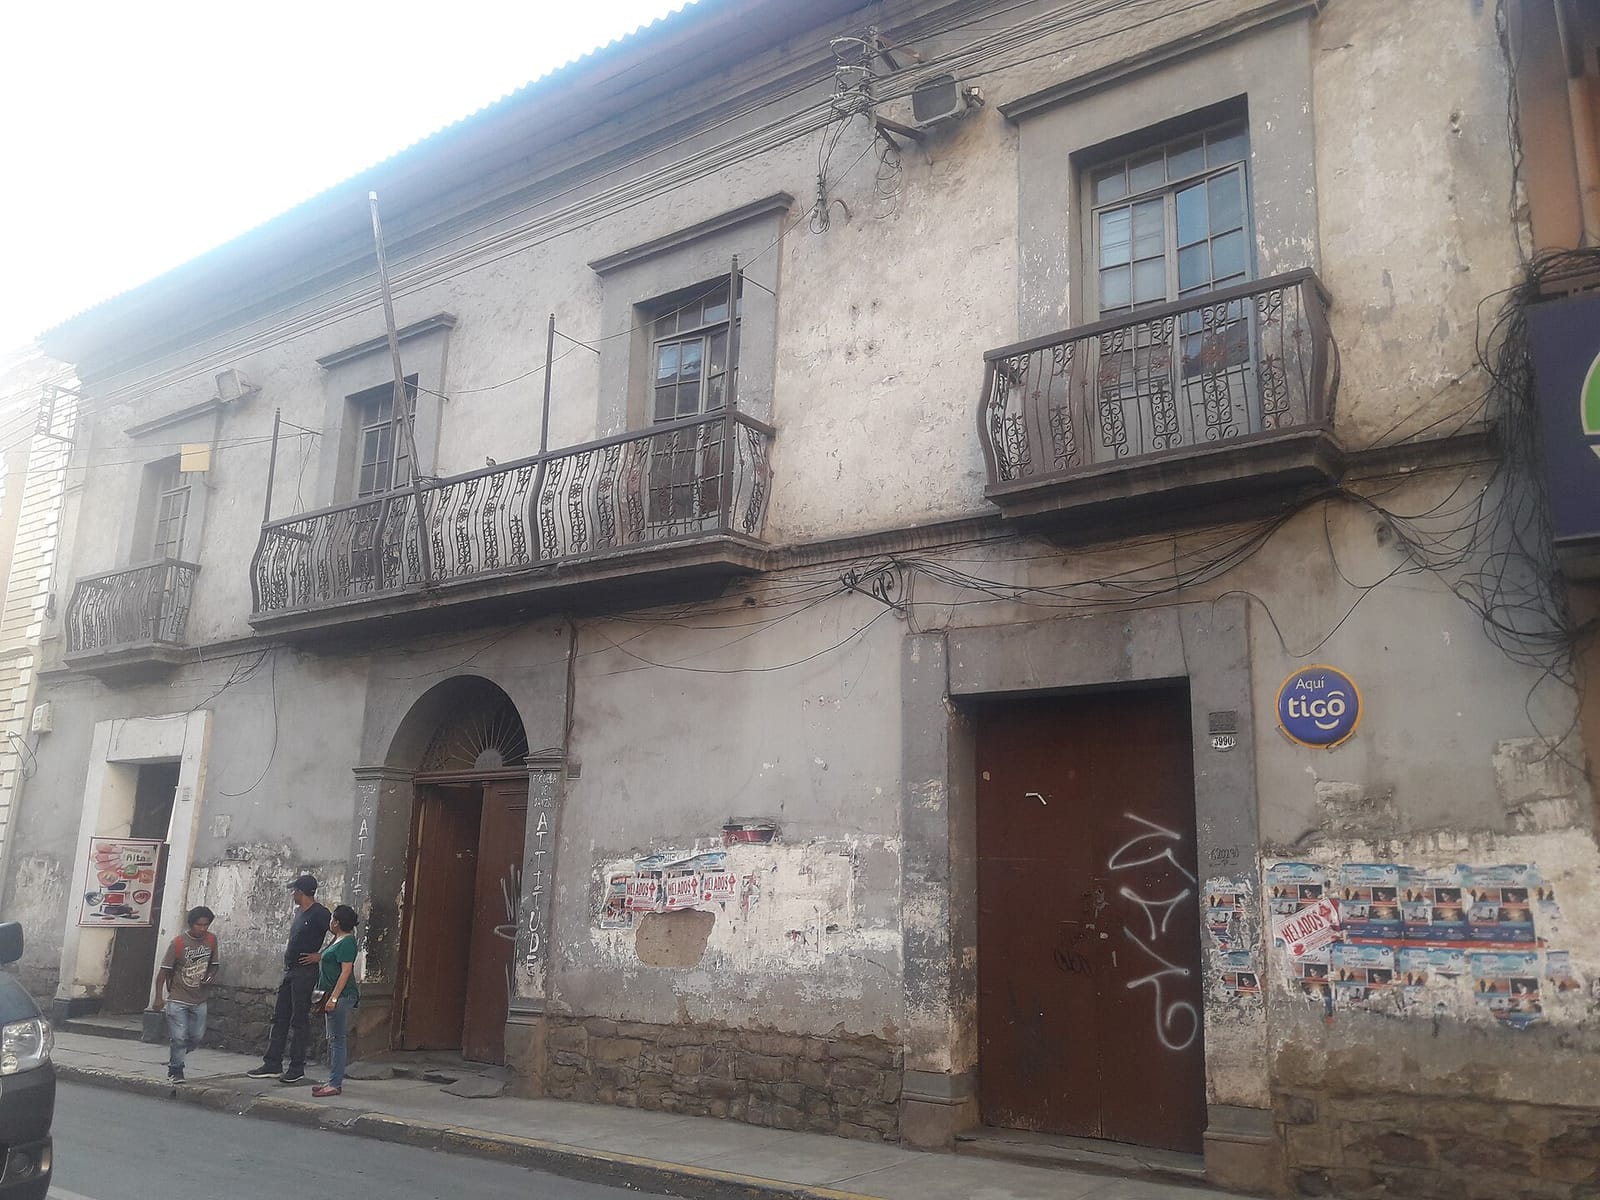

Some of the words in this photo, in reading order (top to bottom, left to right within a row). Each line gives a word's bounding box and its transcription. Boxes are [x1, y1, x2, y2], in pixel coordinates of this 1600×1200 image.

[1295, 676, 1325, 692] Aquí
[1288, 690, 1345, 718] tigo
[1214, 736, 1233, 746] 3990
[627, 882, 650, 896] HELADOS
[667, 879, 691, 896] HELADOS
[704, 876, 729, 891] HELADOS
[1281, 911, 1325, 945] HELADOS
